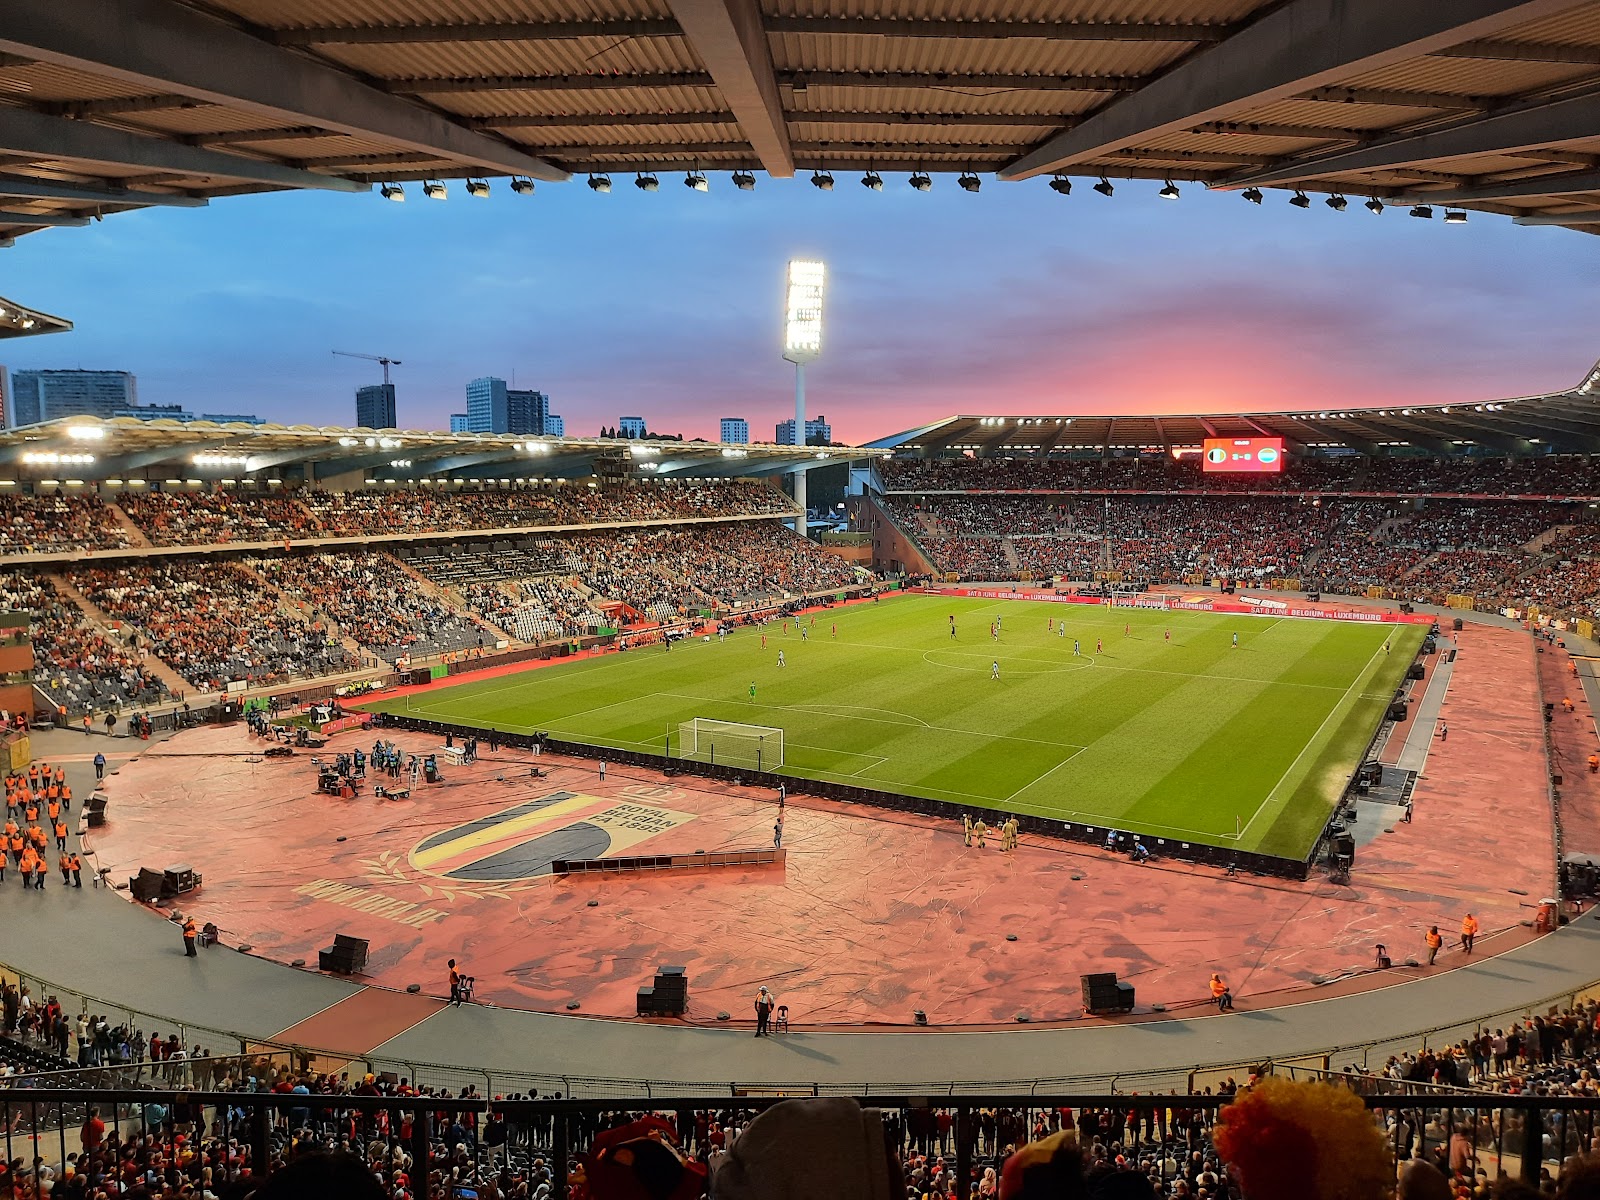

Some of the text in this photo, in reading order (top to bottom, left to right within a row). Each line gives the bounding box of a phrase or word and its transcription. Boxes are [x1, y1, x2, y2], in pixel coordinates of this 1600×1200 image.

[1030, 594, 1067, 602] LUXEMBURG
[1171, 602, 1213, 610] LUXEMBURG
[1250, 606, 1264, 614] SAT
[1291, 609, 1324, 617] BELGIUM
[1333, 612, 1382, 621] LUXEMBURG
[602, 809, 677, 827] BELGIAN
[615, 804, 669, 818] ROYAL
[588, 815, 664, 833] FA 1895
